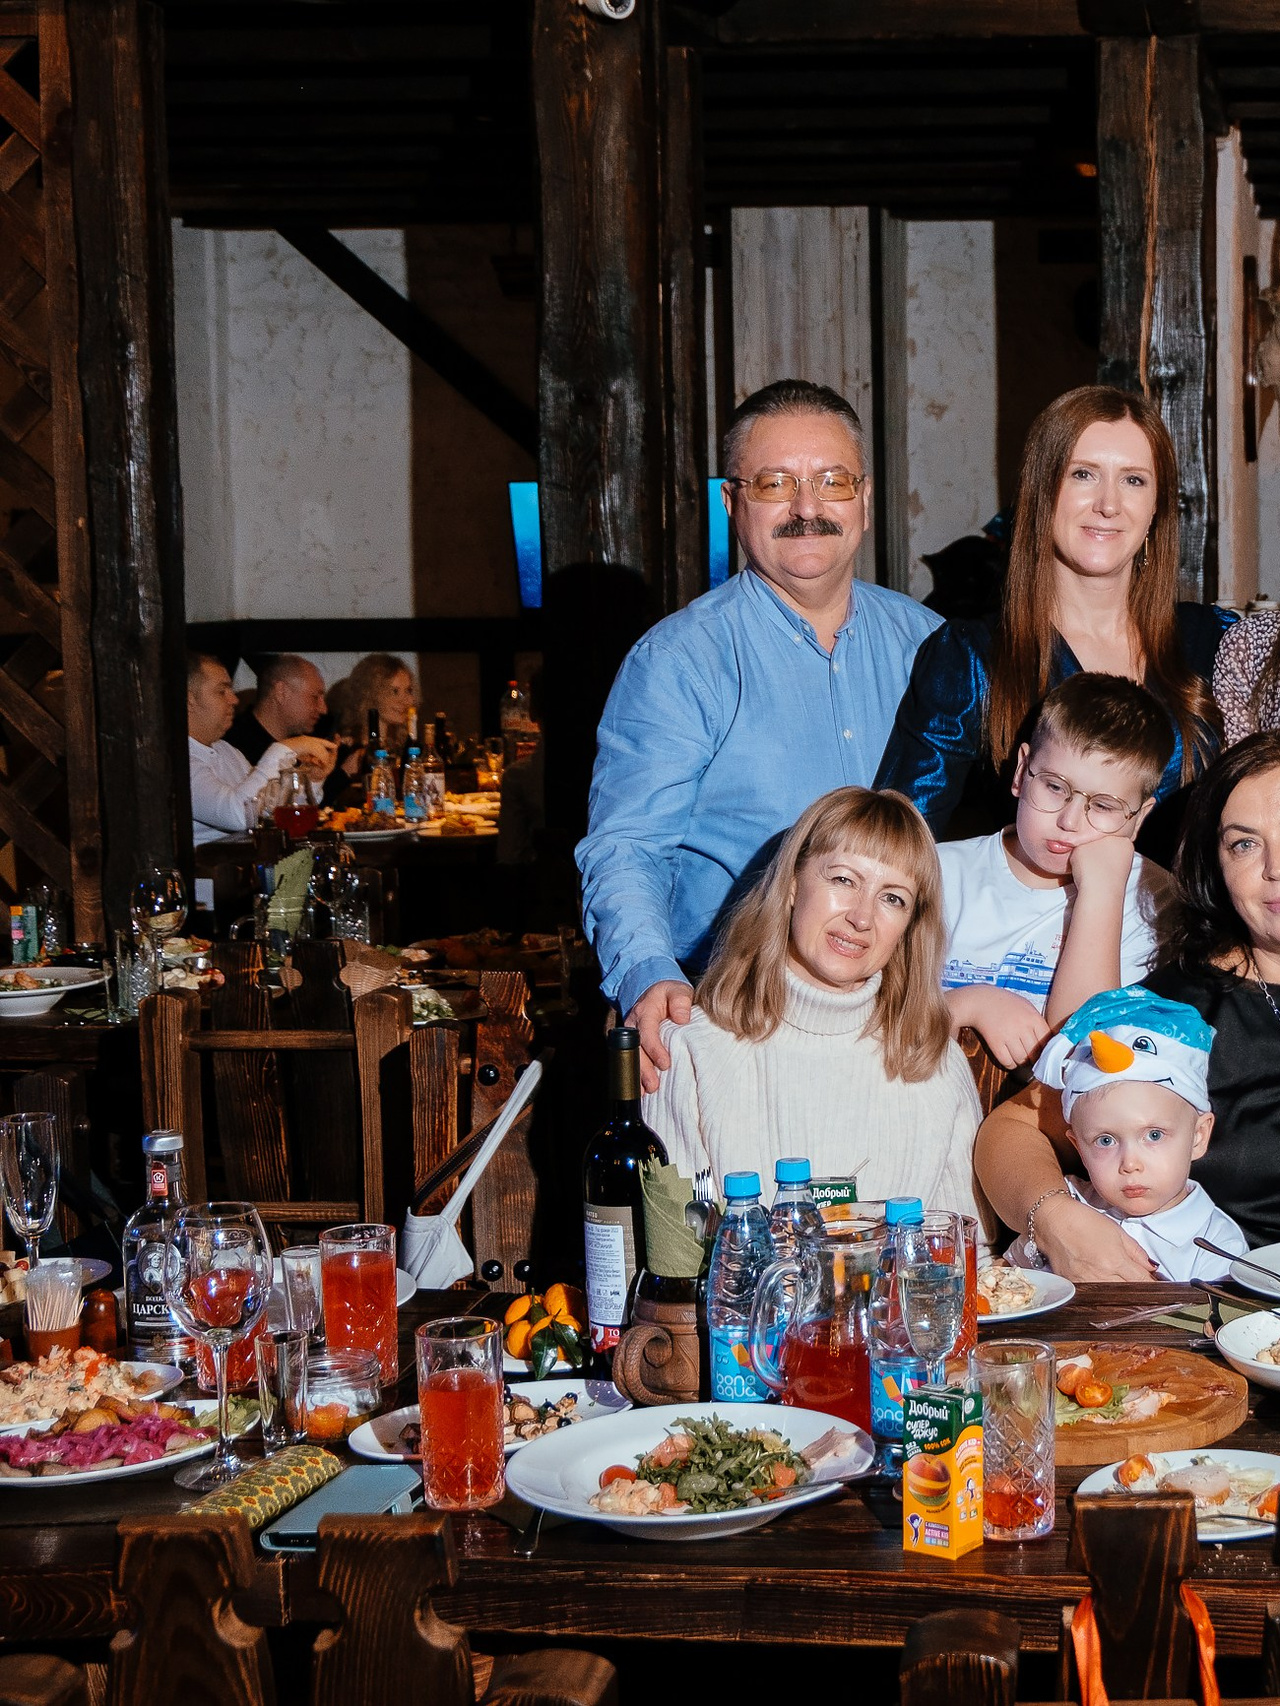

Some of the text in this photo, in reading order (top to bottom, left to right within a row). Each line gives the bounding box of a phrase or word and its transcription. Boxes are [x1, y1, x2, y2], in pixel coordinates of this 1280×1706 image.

[813, 1186, 850, 1200] Добрый
[133, 1303, 170, 1316] ЦАРСК
[607, 1328, 620, 1337] TO
[716, 1370, 756, 1386] bona
[716, 1384, 757, 1400] aqua
[908, 1400, 949, 1421] Добрый
